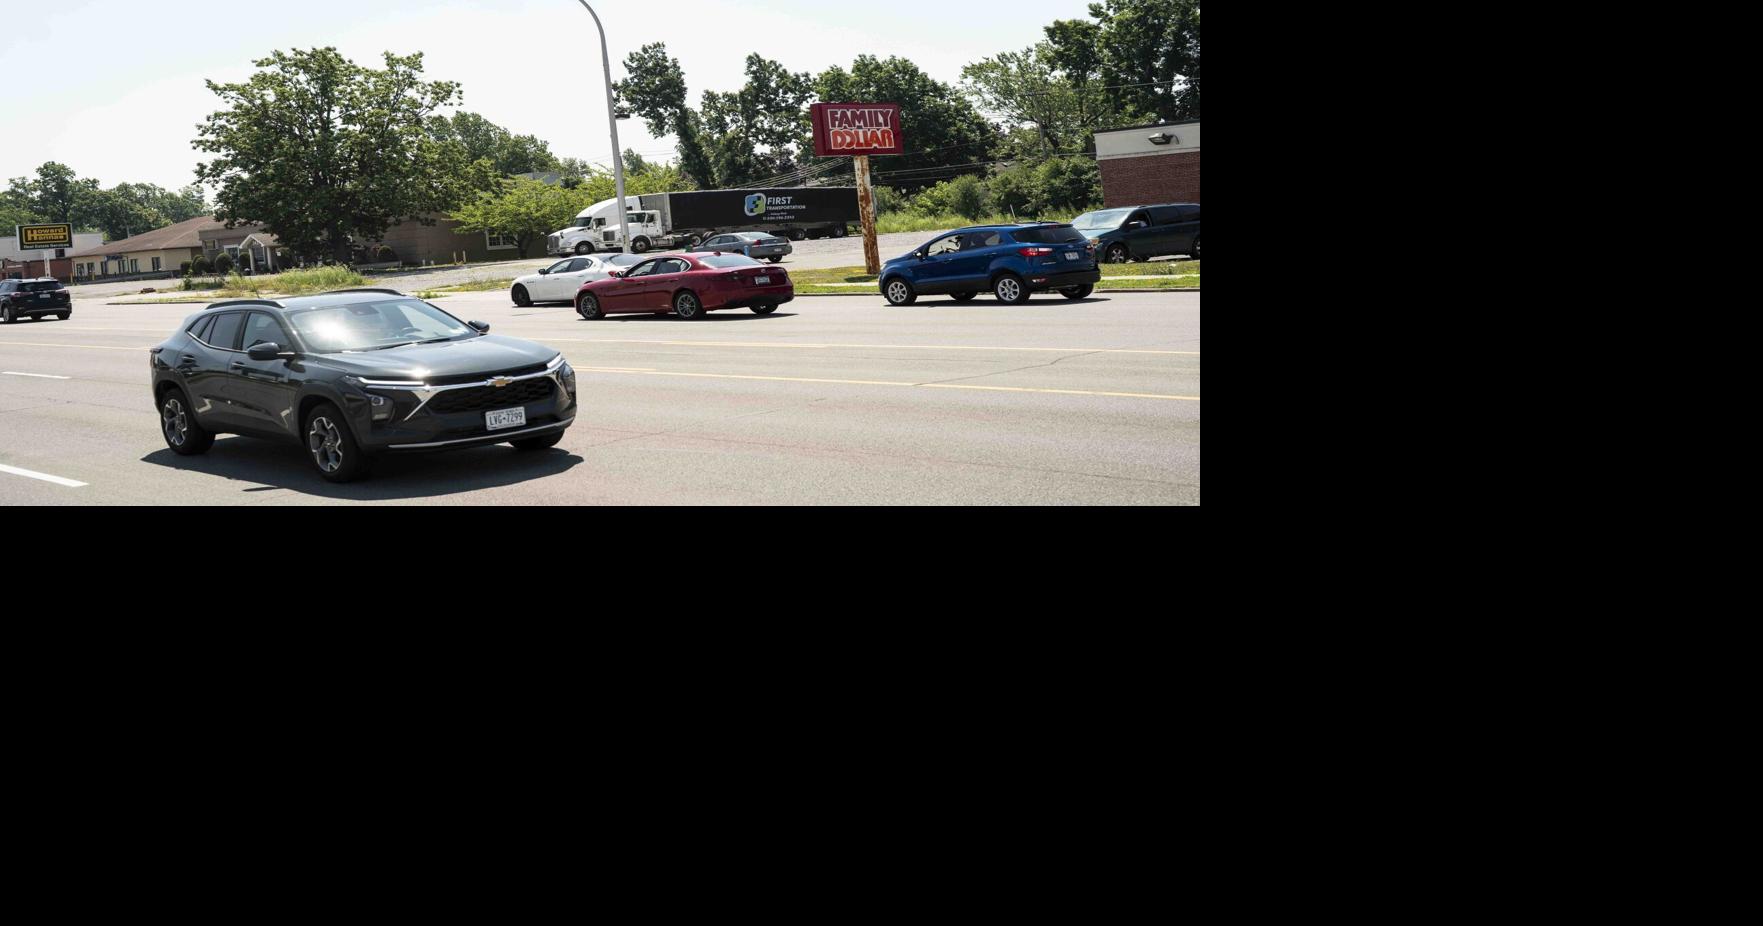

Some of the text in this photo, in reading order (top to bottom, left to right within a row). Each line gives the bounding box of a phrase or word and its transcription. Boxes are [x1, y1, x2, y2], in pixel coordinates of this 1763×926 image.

[828, 109, 893, 129] FAMILY
[830, 129, 895, 149] DOLLAR
[767, 197, 792, 205] FIRST
